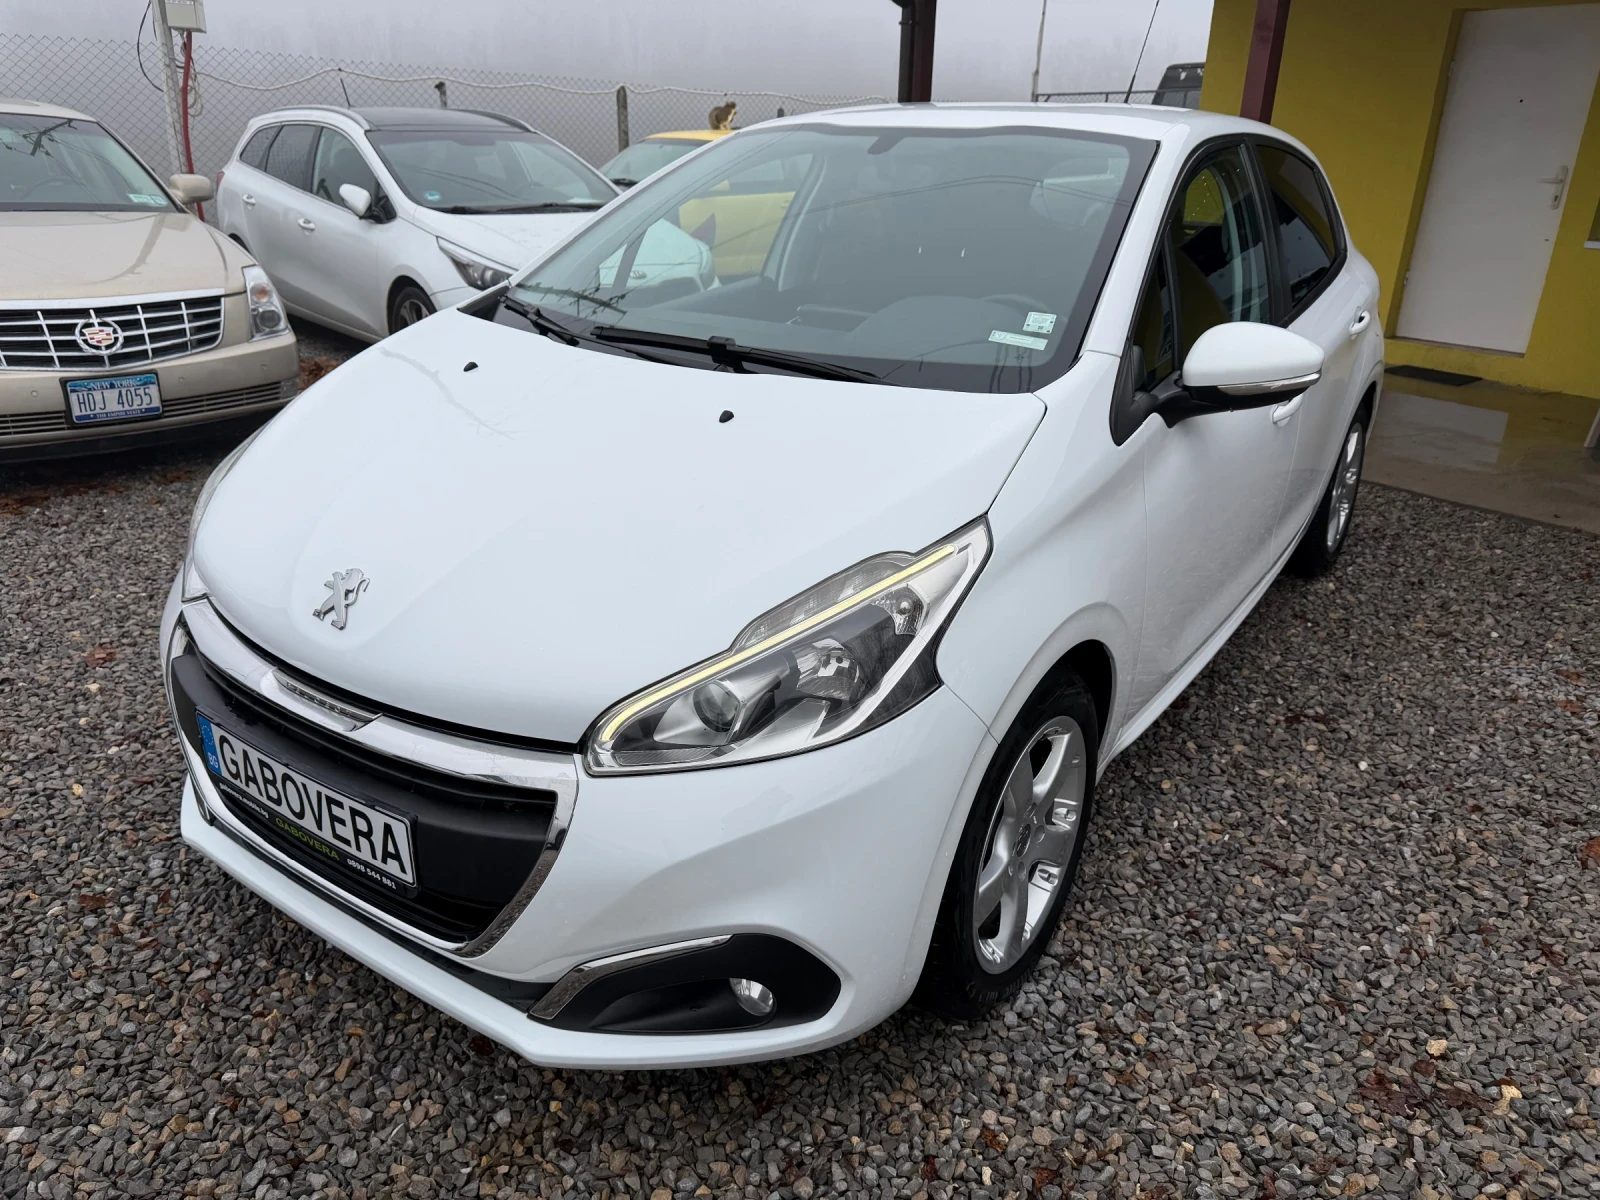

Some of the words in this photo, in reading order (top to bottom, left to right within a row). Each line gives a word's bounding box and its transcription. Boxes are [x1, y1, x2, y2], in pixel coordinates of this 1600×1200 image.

[90, 382, 110, 390] NEW
[114, 380, 136, 388] YORK
[77, 391, 106, 413] HDJ
[117, 387, 152, 408] 4055
[207, 752, 219, 769] BG
[219, 734, 407, 876] GABOVERA
[275, 817, 340, 861] GABOVERA
[366, 867, 381, 881] 544
